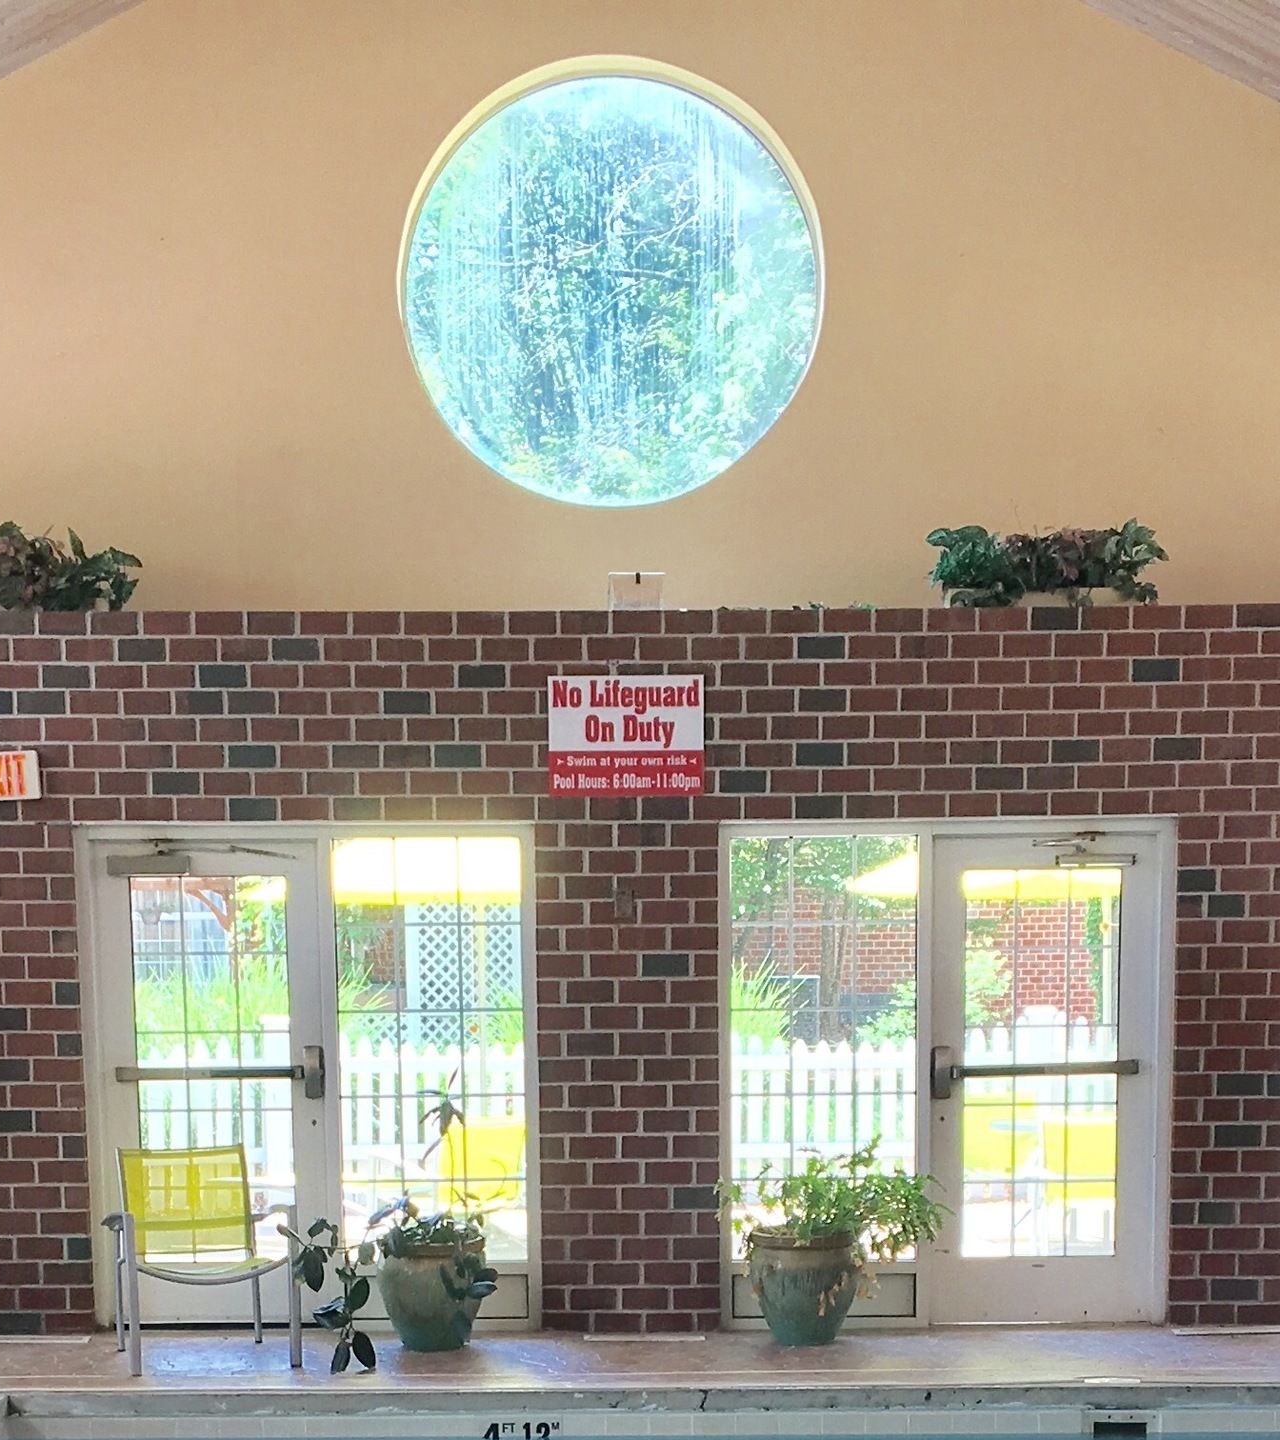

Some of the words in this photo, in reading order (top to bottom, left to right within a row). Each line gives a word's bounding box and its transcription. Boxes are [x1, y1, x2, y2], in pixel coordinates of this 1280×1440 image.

[552, 680, 582, 708] No
[589, 679, 700, 715] Lifeguard
[584, 714, 615, 743] On
[623, 714, 675, 748] Duty
[567, 755, 597, 767] Swim
[600, 756, 611, 767] at
[614, 757, 638, 769] your
[641, 756, 664, 767] own
[667, 754, 687, 767] risk
[553, 773, 575, 790] Pool
[578, 773, 610, 790] Hours:
[613, 772, 701, 792] 6:00am-11:00pm
